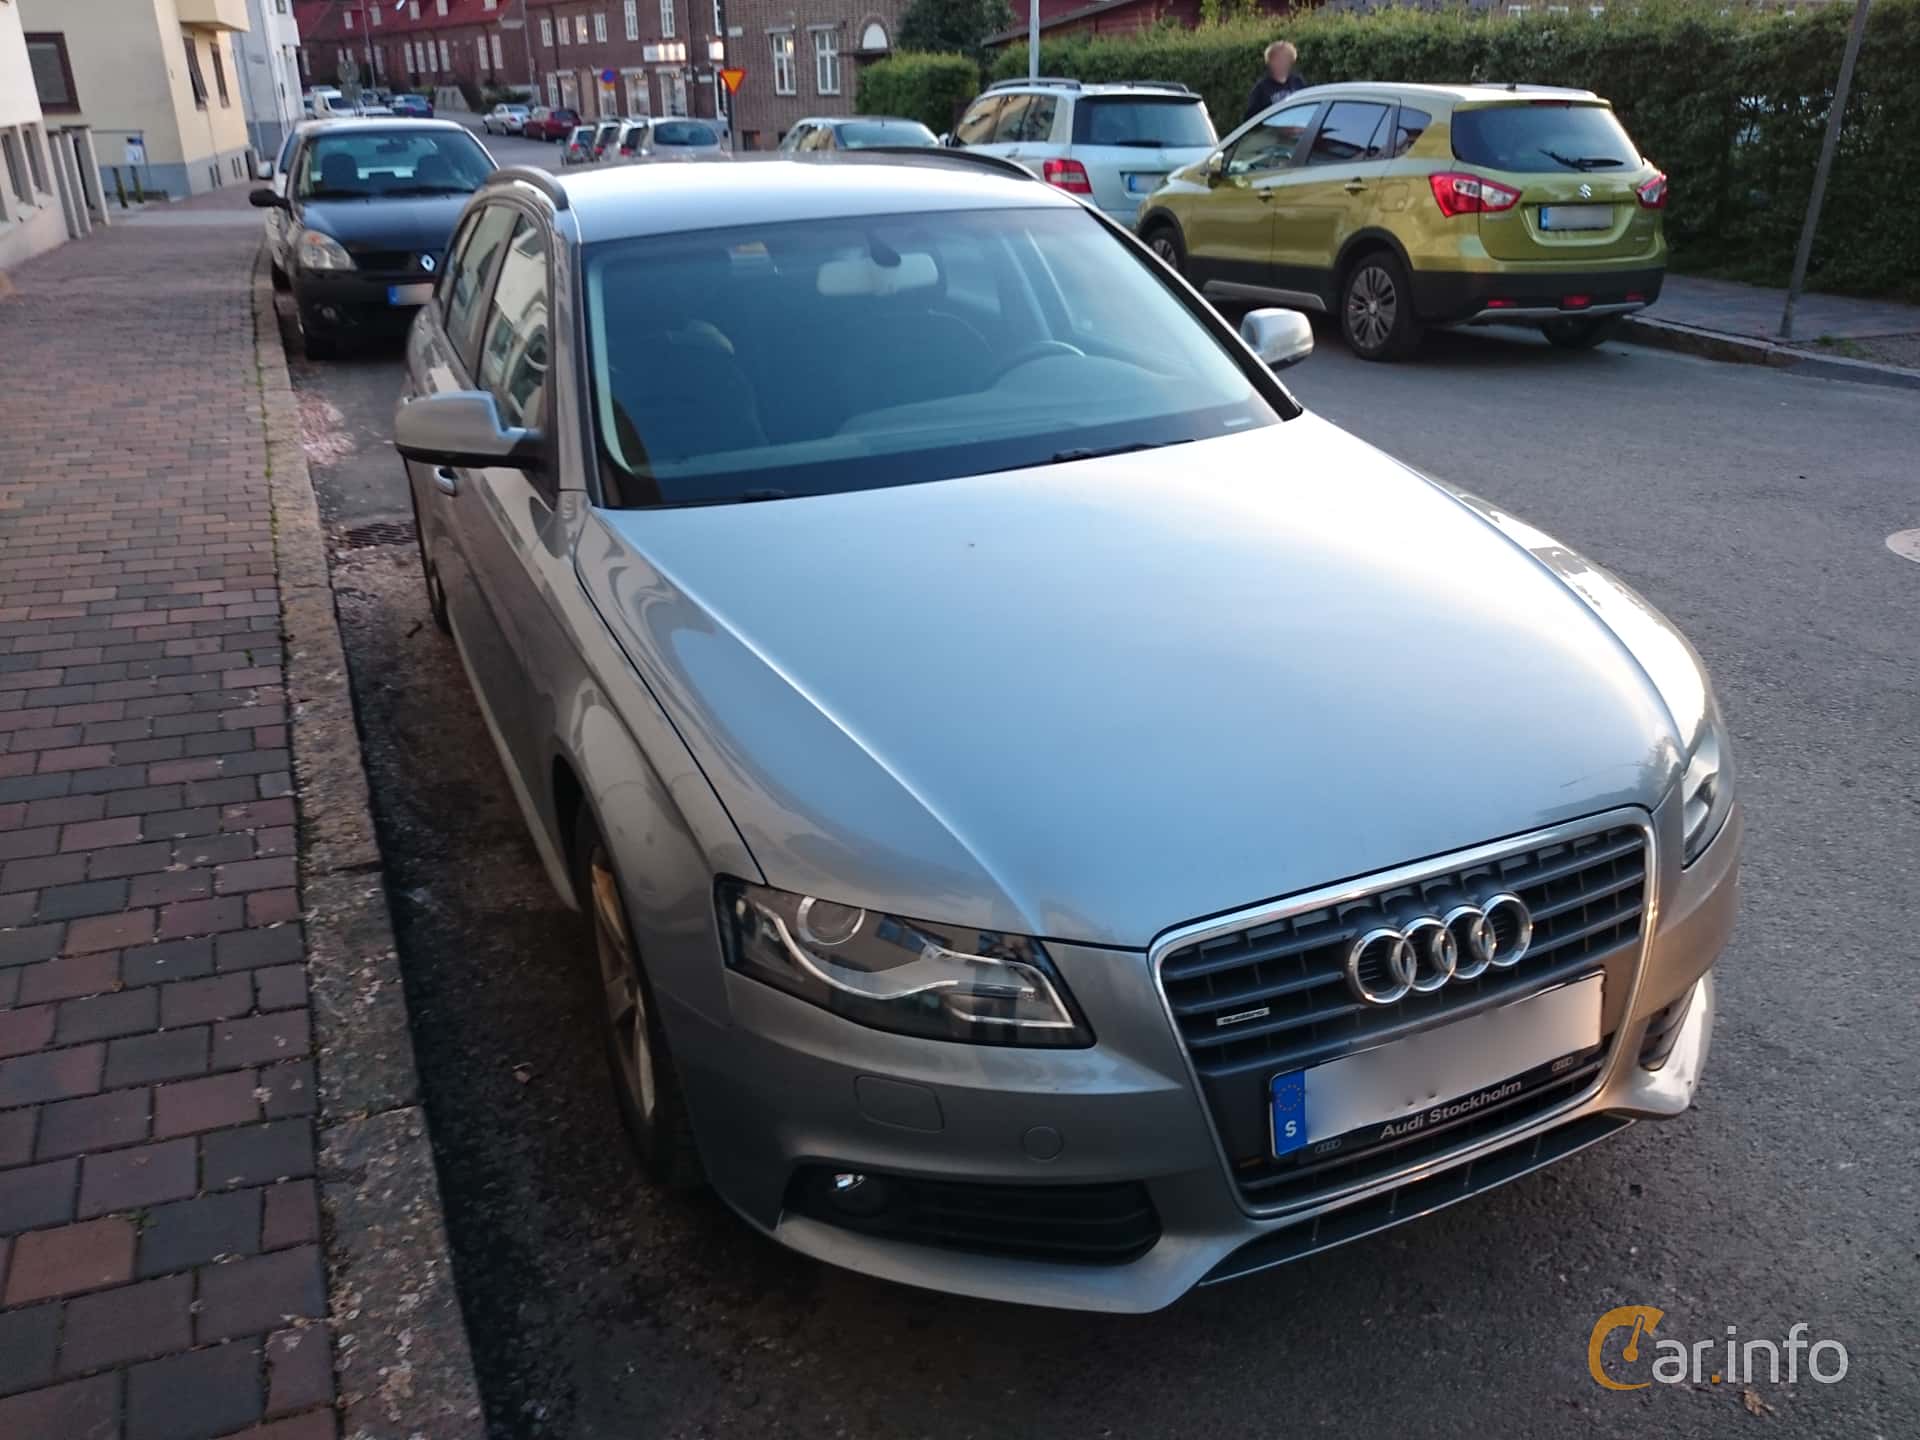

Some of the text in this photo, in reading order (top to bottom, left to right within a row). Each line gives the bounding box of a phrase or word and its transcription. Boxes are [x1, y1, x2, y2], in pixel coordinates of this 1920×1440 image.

[1285, 1120, 1297, 1137] S
[1380, 1080, 1522, 1139] Audi Stockholm
